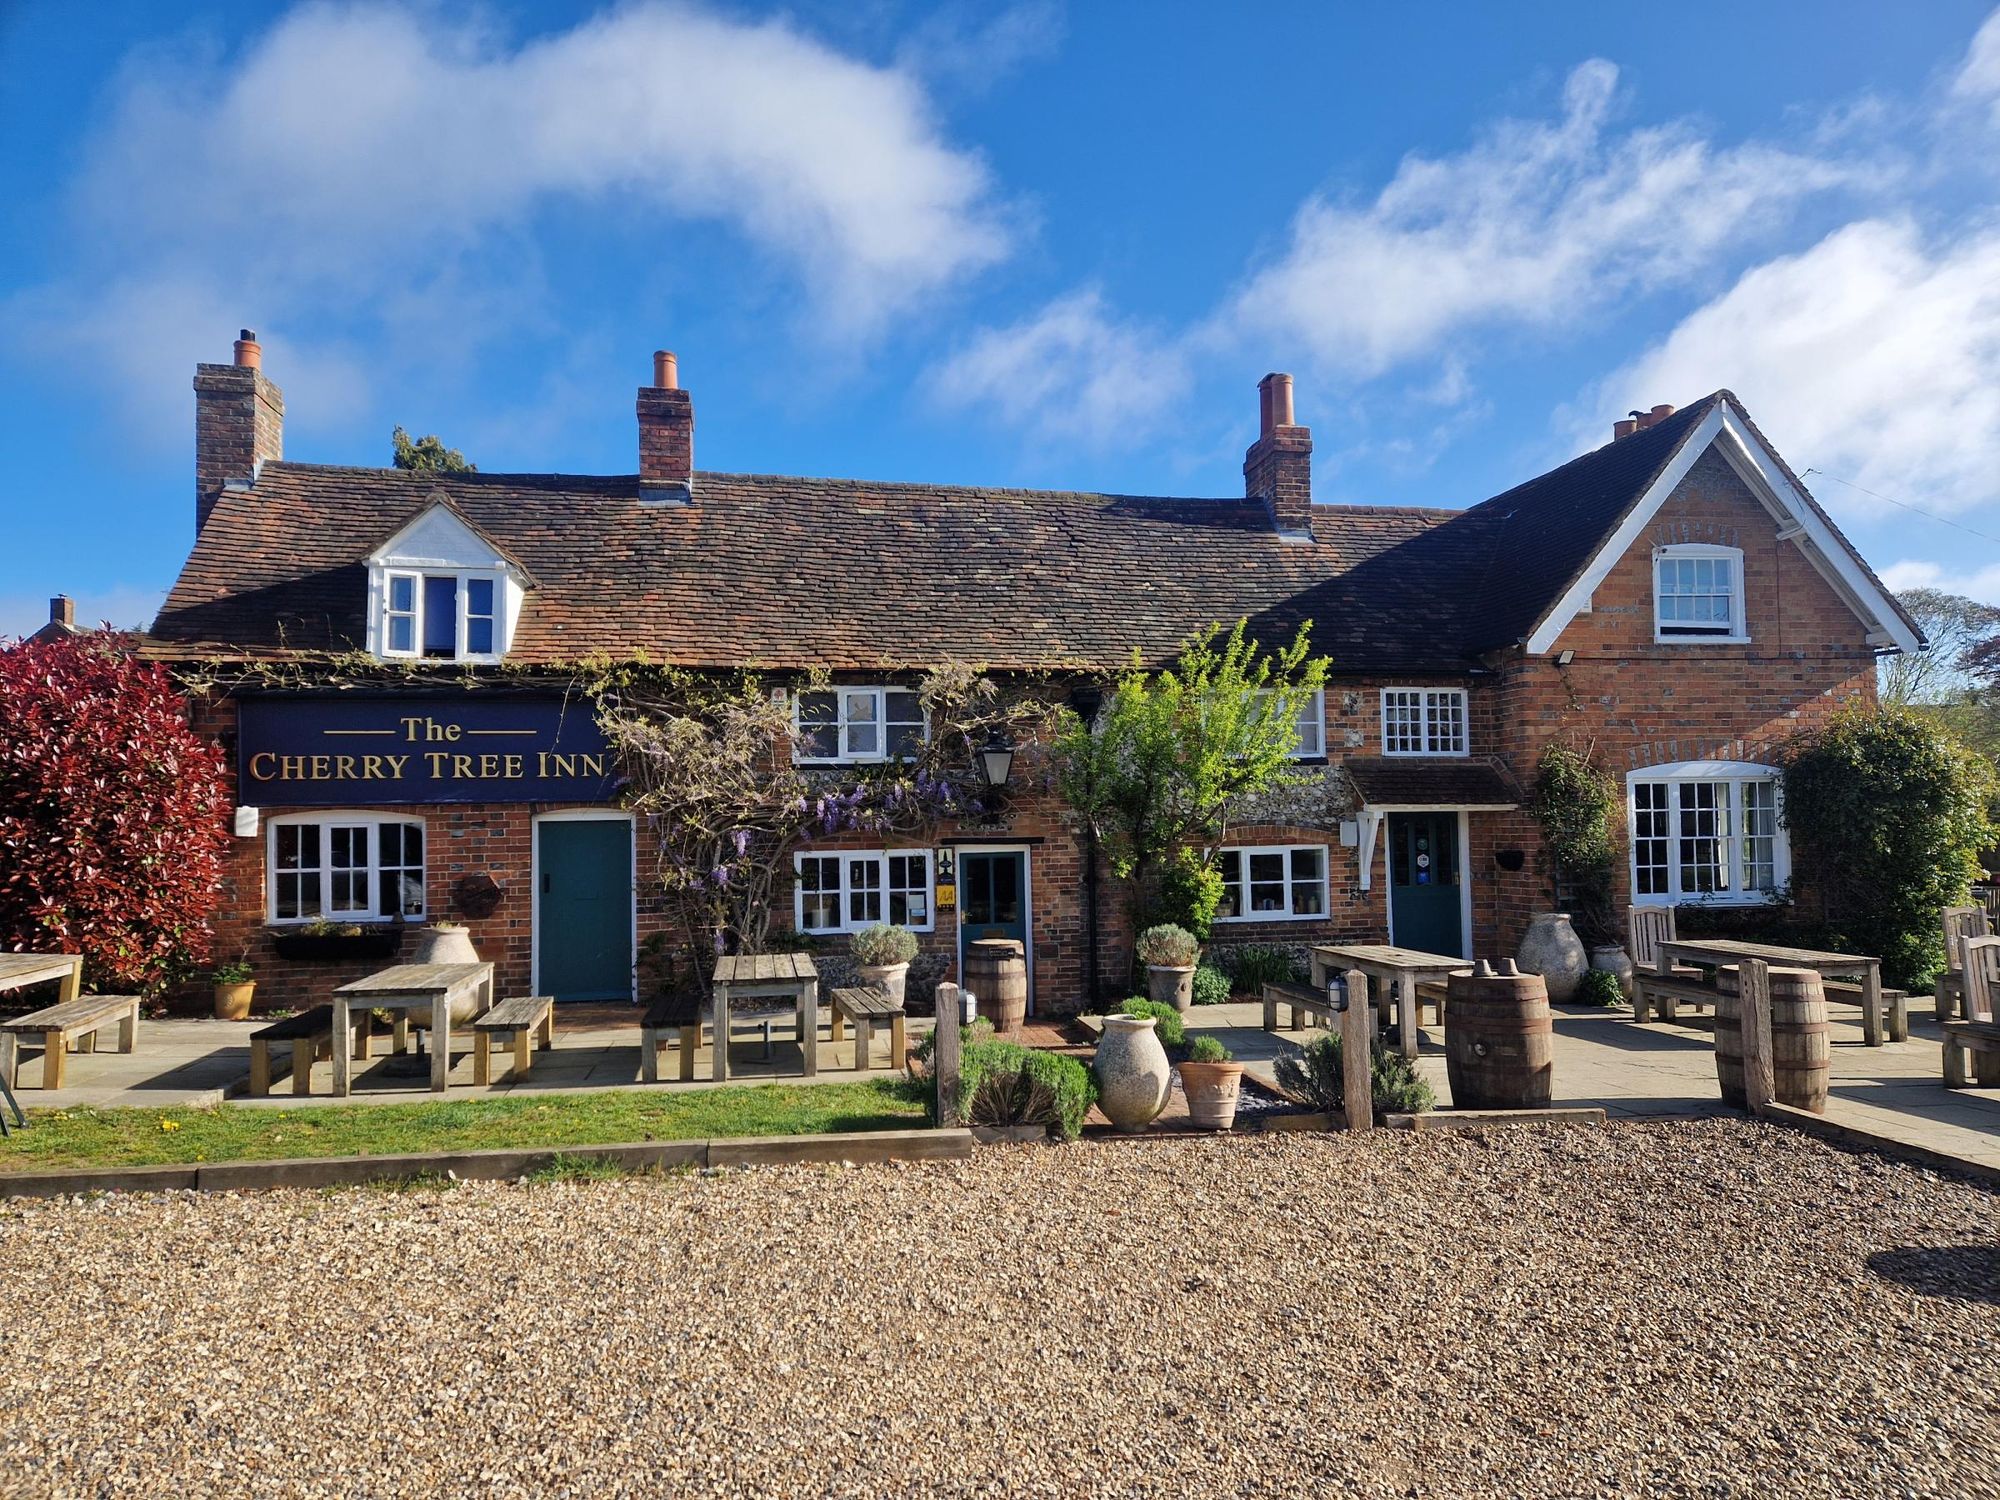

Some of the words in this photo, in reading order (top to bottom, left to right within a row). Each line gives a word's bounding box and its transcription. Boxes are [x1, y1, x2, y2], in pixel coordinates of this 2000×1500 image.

[401, 717, 462, 742] The
[250, 752, 411, 781] CHERRY
[424, 752, 524, 779] TREE
[537, 751, 605, 778] INN
